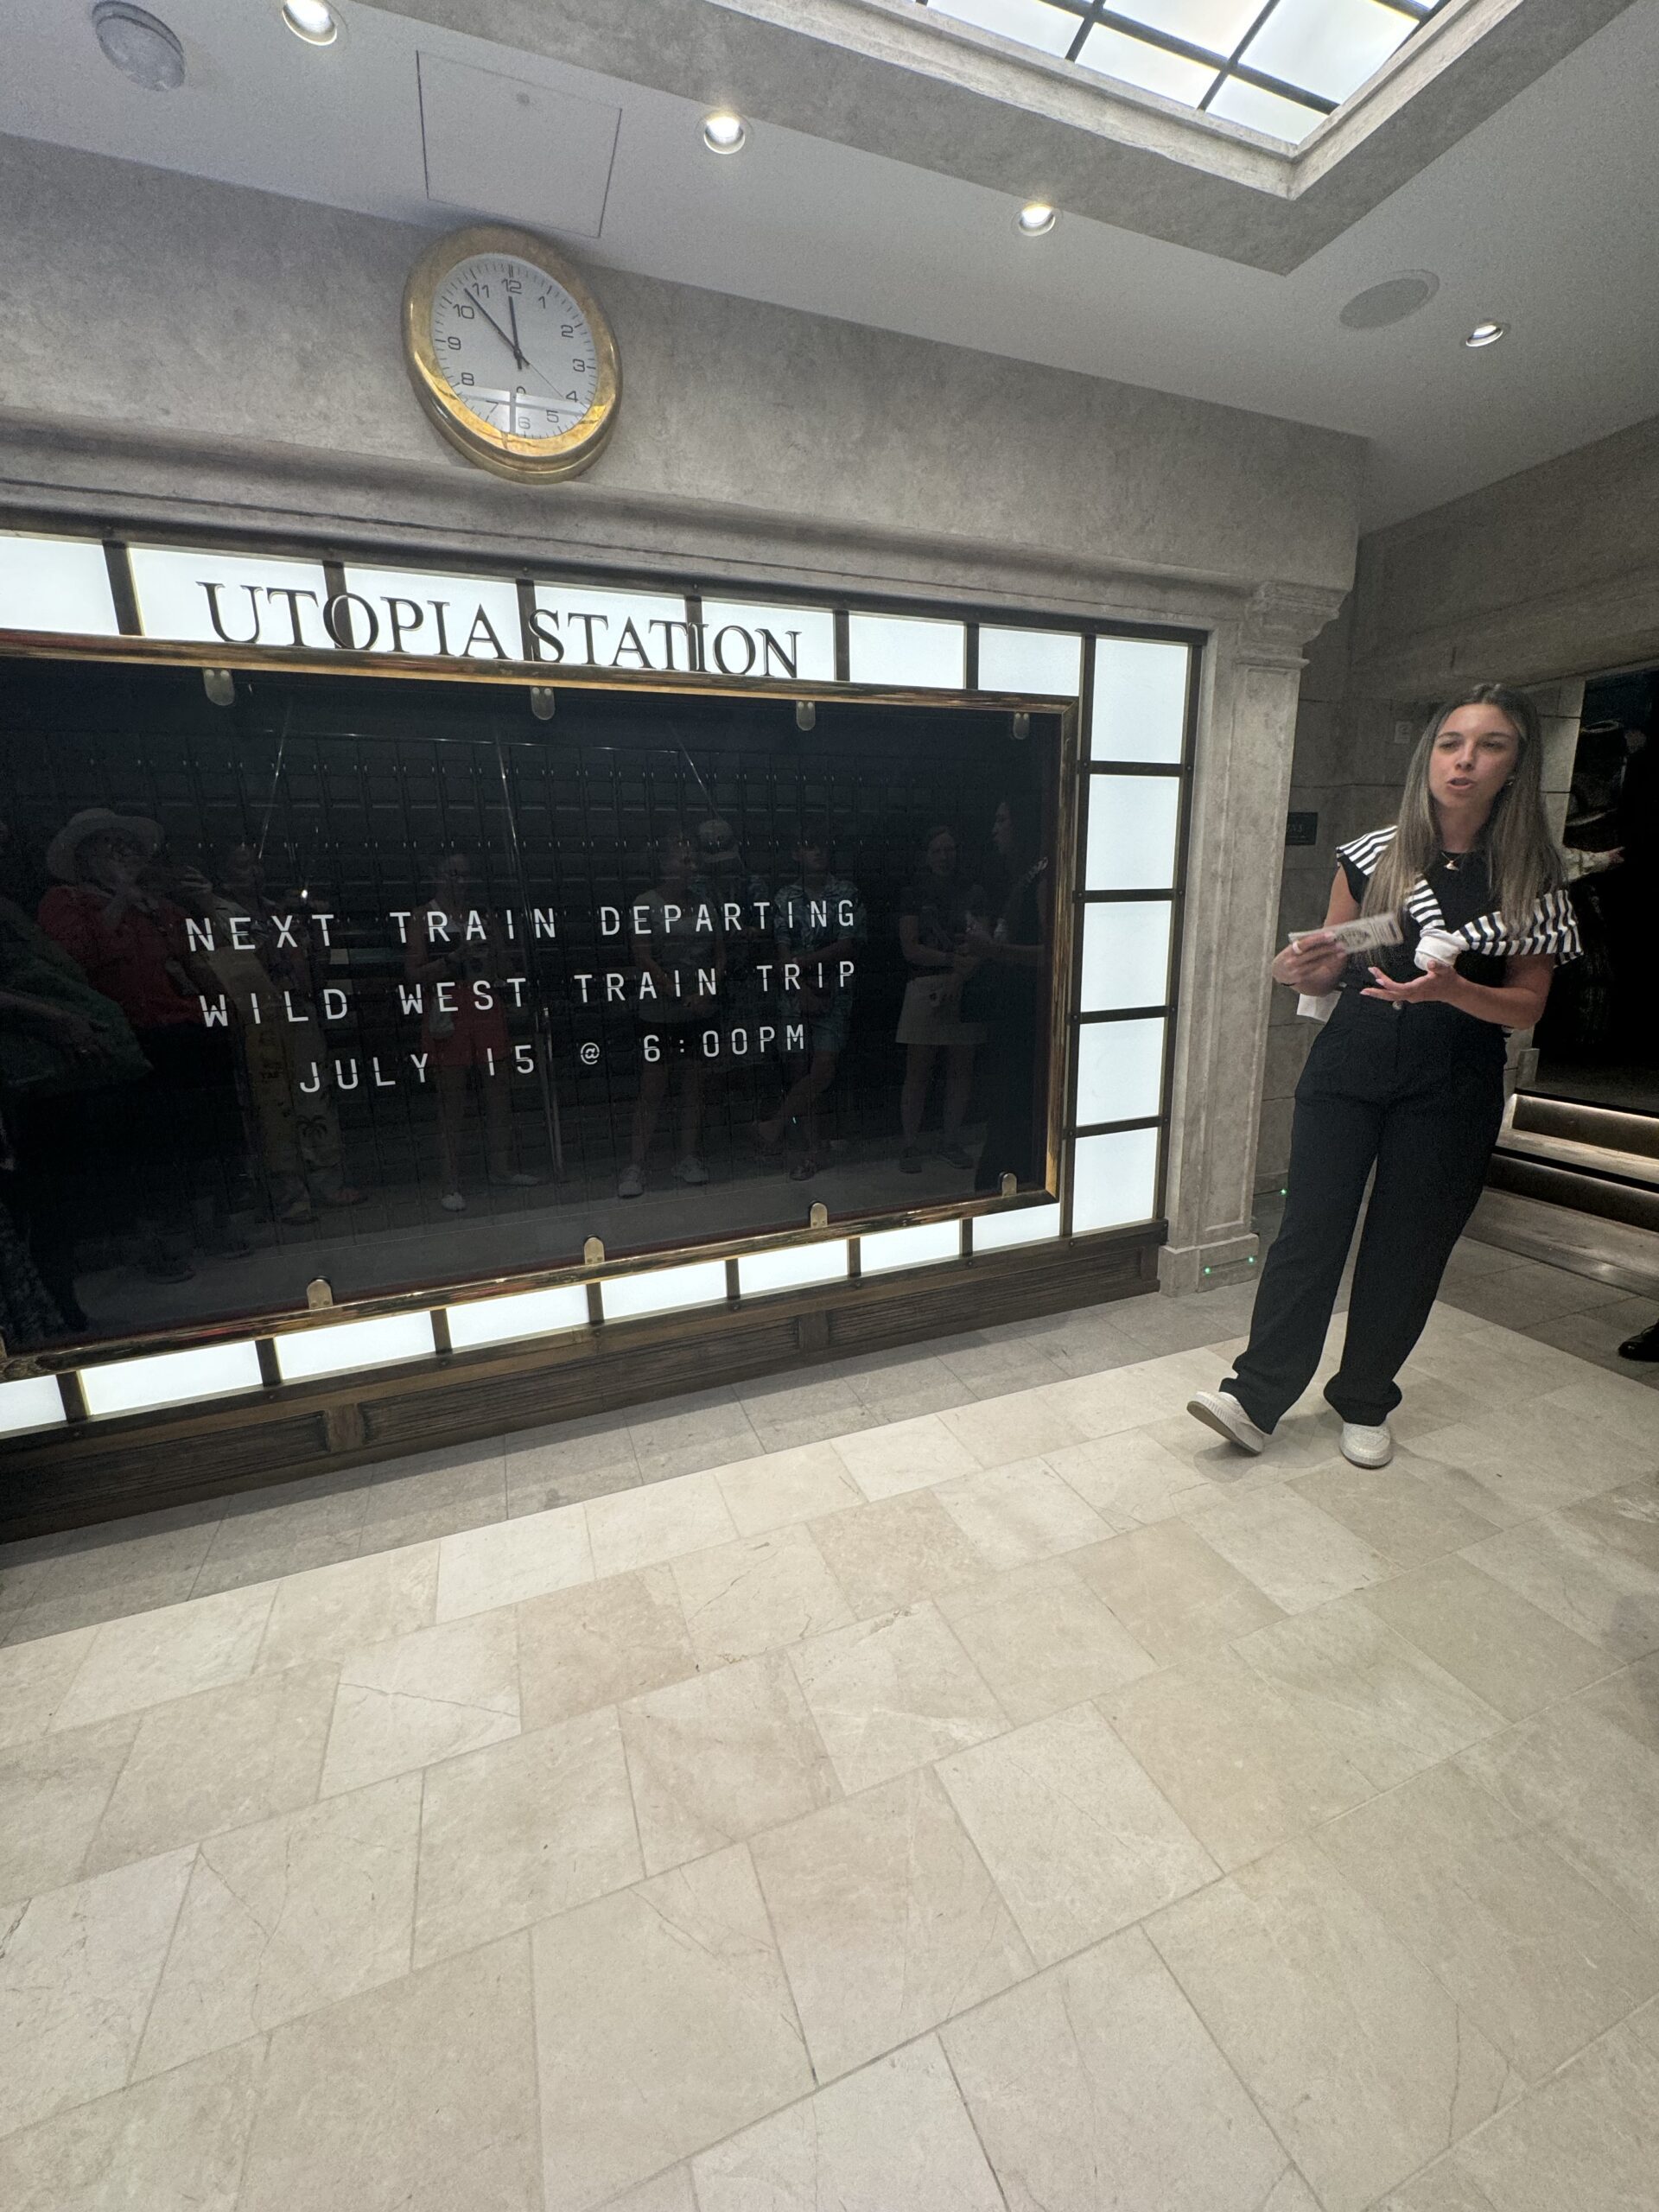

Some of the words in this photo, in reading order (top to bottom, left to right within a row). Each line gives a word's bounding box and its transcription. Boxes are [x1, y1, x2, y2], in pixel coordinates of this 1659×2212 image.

[472, 283, 490, 298] 11
[501, 278, 523, 295] 12
[538, 296, 546, 309] 1
[453, 303, 475, 320] 10
[561, 324, 575, 338] 2
[447, 336, 461, 351] 9
[572, 359, 586, 372] 3
[461, 372, 475, 386] 8
[565, 390, 579, 403] 4
[485, 400, 499, 414] 7
[518, 416, 531, 429] 6
[546, 410, 560, 423] 5
[195, 581, 513, 660] UTOPIA
[528, 608, 802, 679] STATION
[185, 914, 335, 952] NEXT
[389, 908, 557, 944] TRAIN
[601, 899, 855, 938] DEPARTING
[199, 988, 347, 1028] WILD
[398, 977, 526, 1015] WEST
[574, 968, 717, 1004] TRAIN
[756, 961, 855, 993] TRIP
[300, 1052, 429, 1094] JULY
[486, 1044, 535, 1077] 15
[580, 1042, 601, 1066] @
[643, 1024, 804, 1063] 6:00PM
